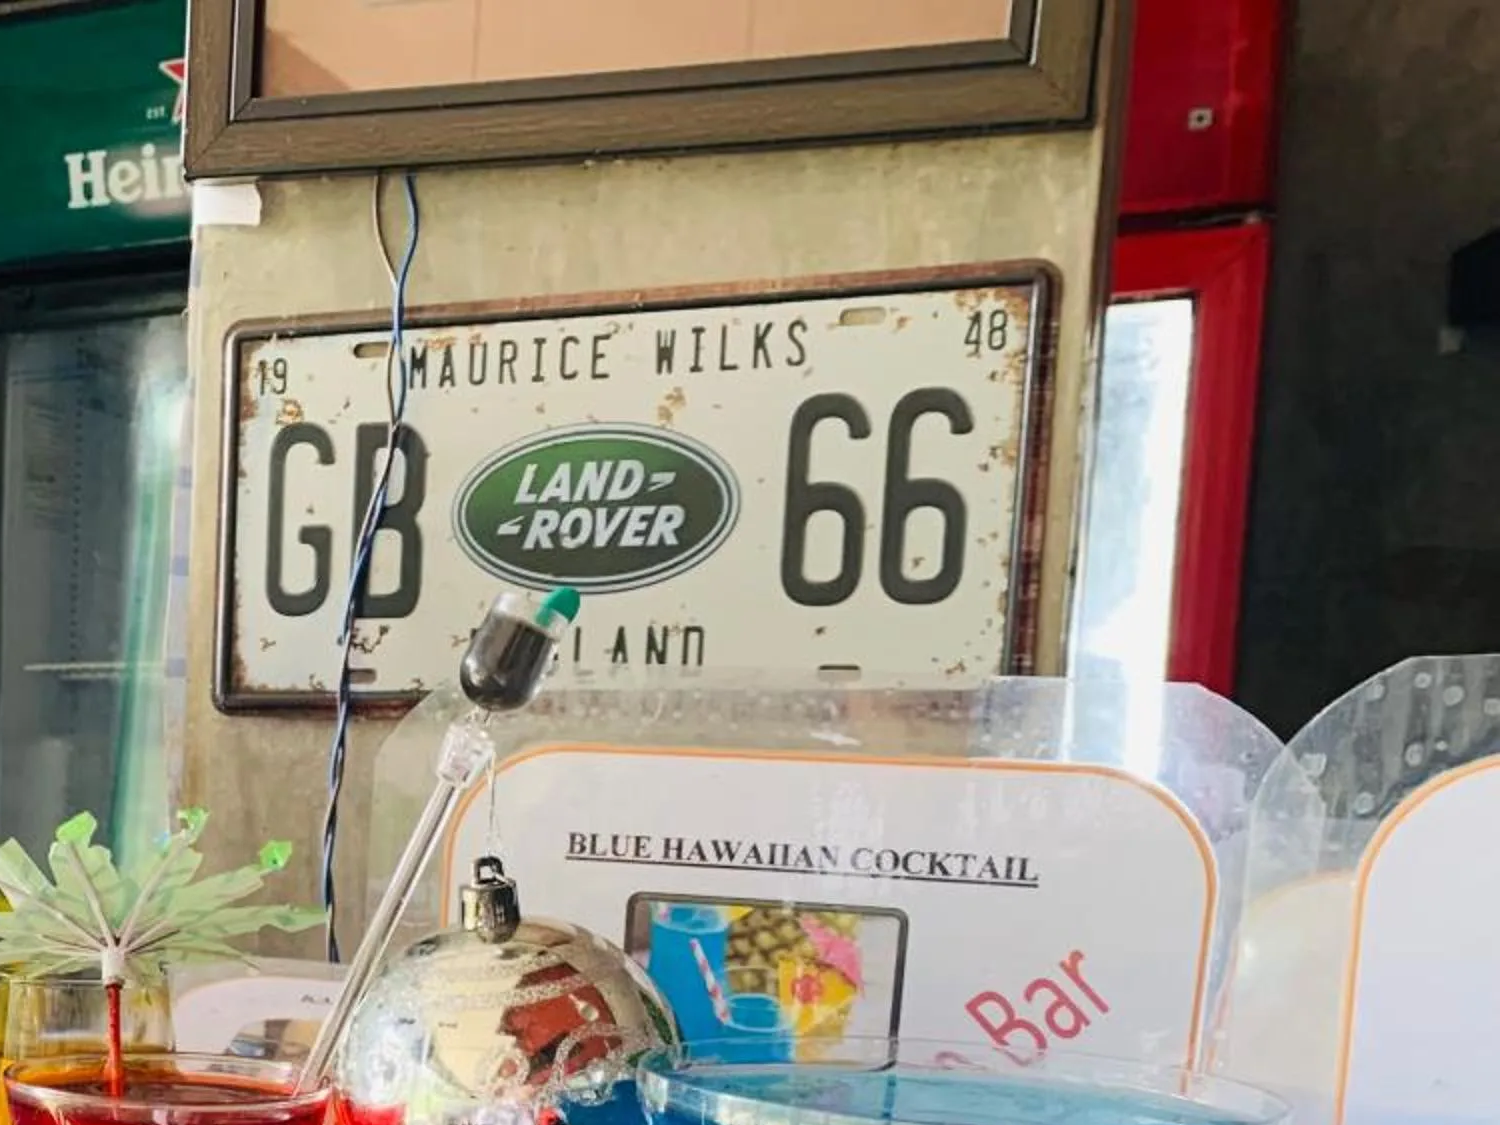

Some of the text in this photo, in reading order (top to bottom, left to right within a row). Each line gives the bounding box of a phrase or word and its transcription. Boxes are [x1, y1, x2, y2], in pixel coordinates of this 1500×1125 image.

[408, 319, 809, 391] MAURICE WILKS
[963, 308, 1009, 358] 48
[257, 357, 288, 396] 19
[266, 421, 426, 618] GB
[779, 386, 976, 607] 66
[513, 459, 646, 505] LAND
[522, 505, 687, 550] ROVER
[567, 831, 1040, 882] BLUE HAWAIIAN COCKTAIL
[963, 949, 1110, 1067] Bar
